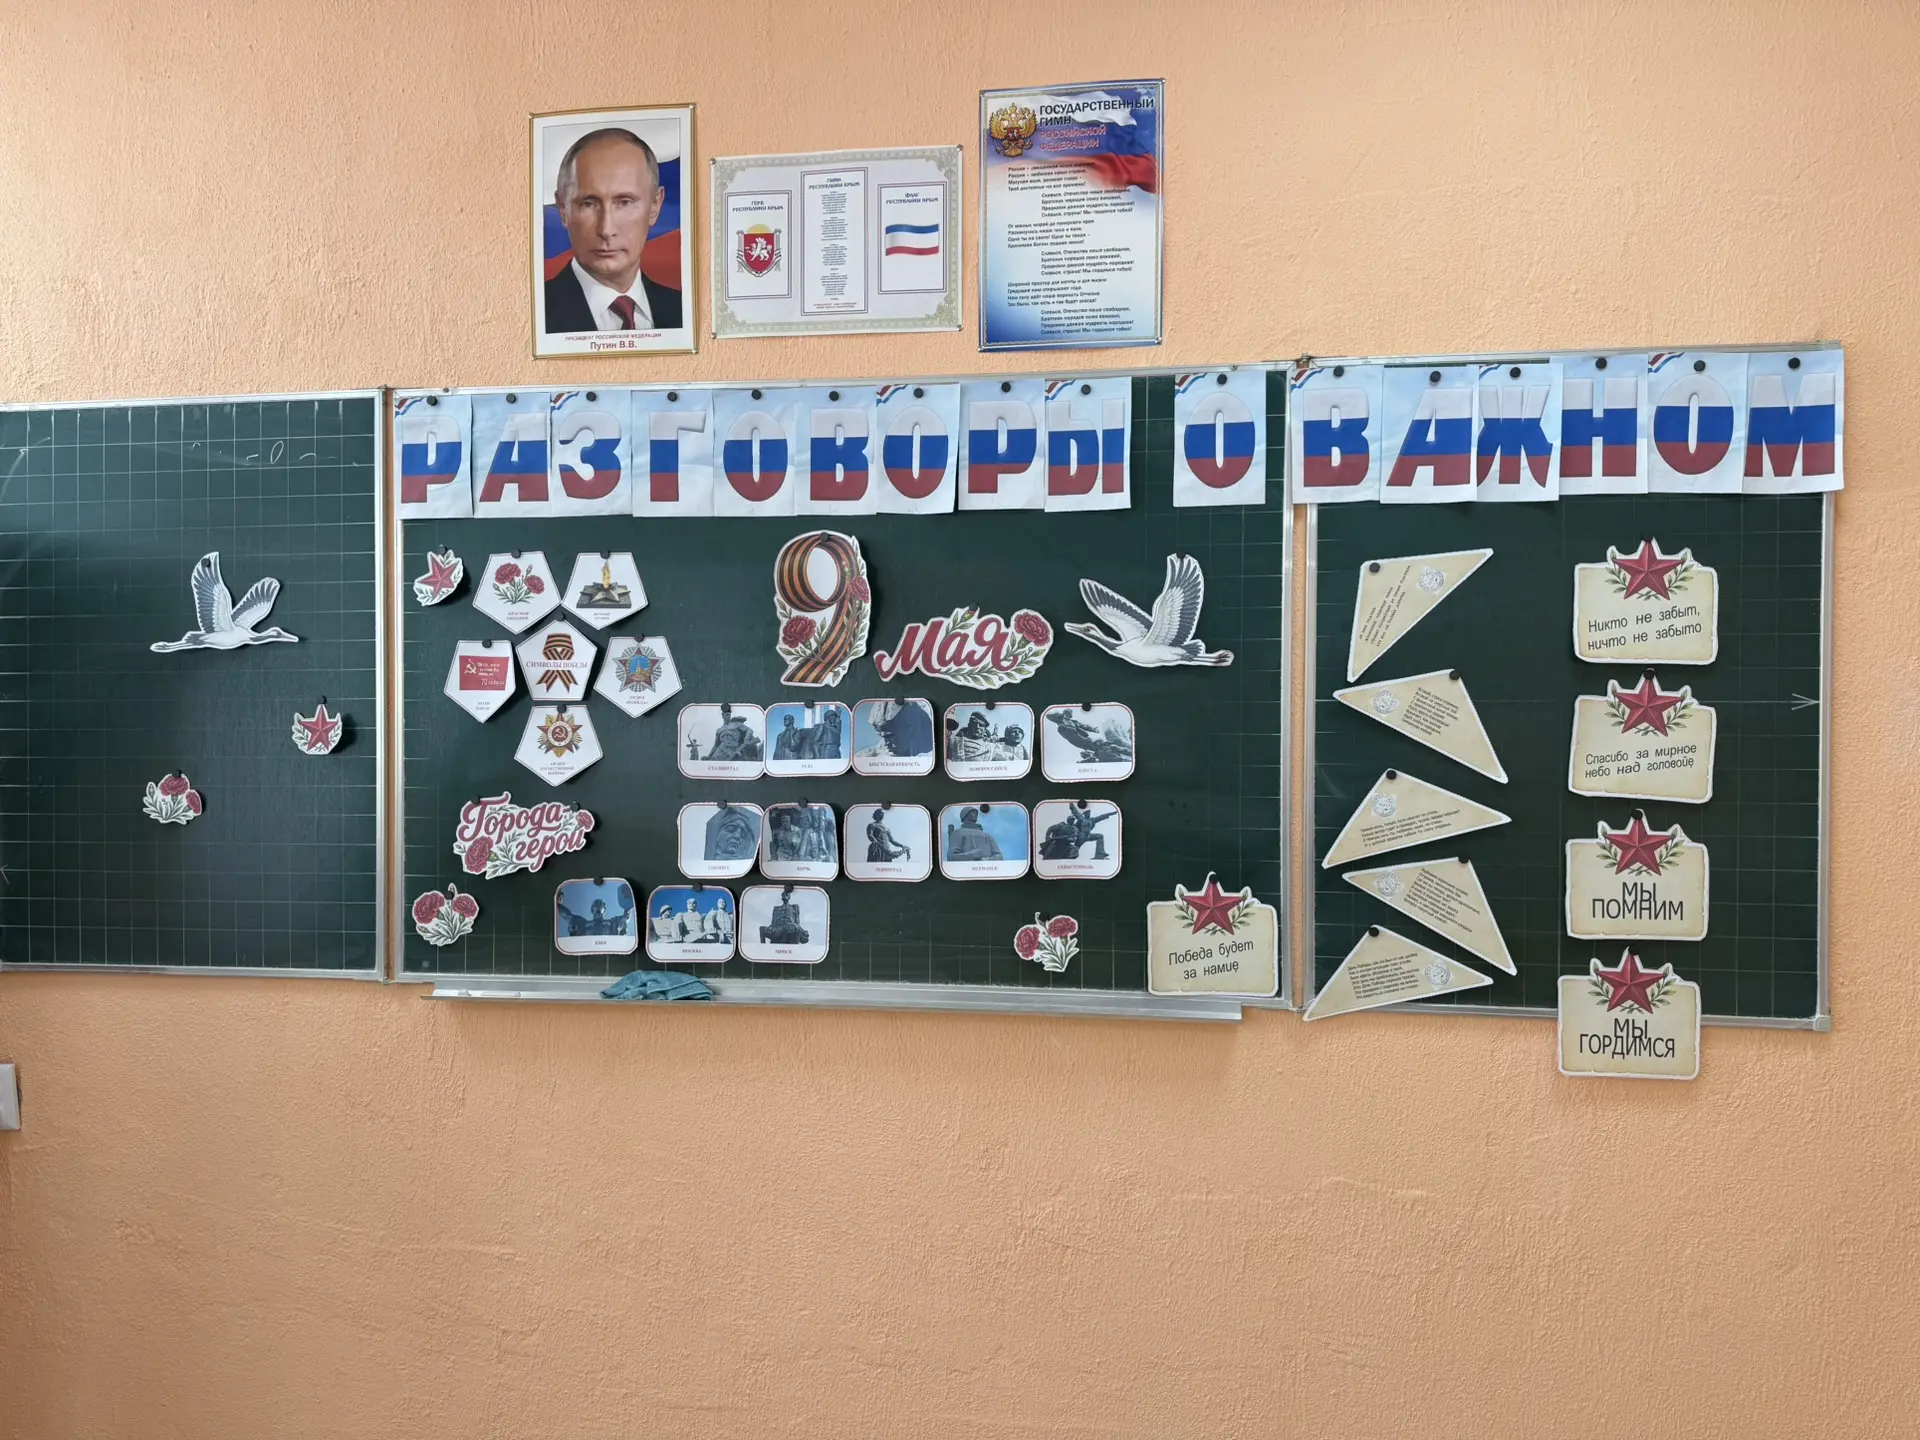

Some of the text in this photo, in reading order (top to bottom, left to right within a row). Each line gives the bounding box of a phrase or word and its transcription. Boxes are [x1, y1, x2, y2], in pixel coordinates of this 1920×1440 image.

[1040, 98, 1154, 115] ГОСУДАРСТВЕННЫЙ
[1040, 116, 1072, 127] ГИМН
[1040, 125, 1106, 139] РОССИЙСКОЙ
[1039, 139, 1099, 151] ФЕДЕРАЦИИ
[590, 340, 637, 351] Путин В.В.
[401, 373, 1836, 503] РАЗГОВОРЫ О ВАЖНОМ
[777, 533, 1019, 684] 9 Мая
[1588, 605, 1700, 633] Никто не забыт,
[1587, 623, 1702, 651] ничто не забыто
[526, 661, 562, 669] СИМВОЛЫ
[1585, 744, 1697, 766] Спасибо за мирное
[1585, 763, 1611, 779] небо
[1616, 760, 1641, 775] над
[515, 828, 586, 871] герои
[1622, 882, 1657, 902] МЫ
[1592, 898, 1684, 920] ПОМНИМ
[1168, 940, 1254, 966] Победа будет
[1183, 969, 1197, 980] за
[1614, 1018, 1648, 1039] МЫ
[1580, 1034, 1675, 1059] ГОРДИМСЯ
